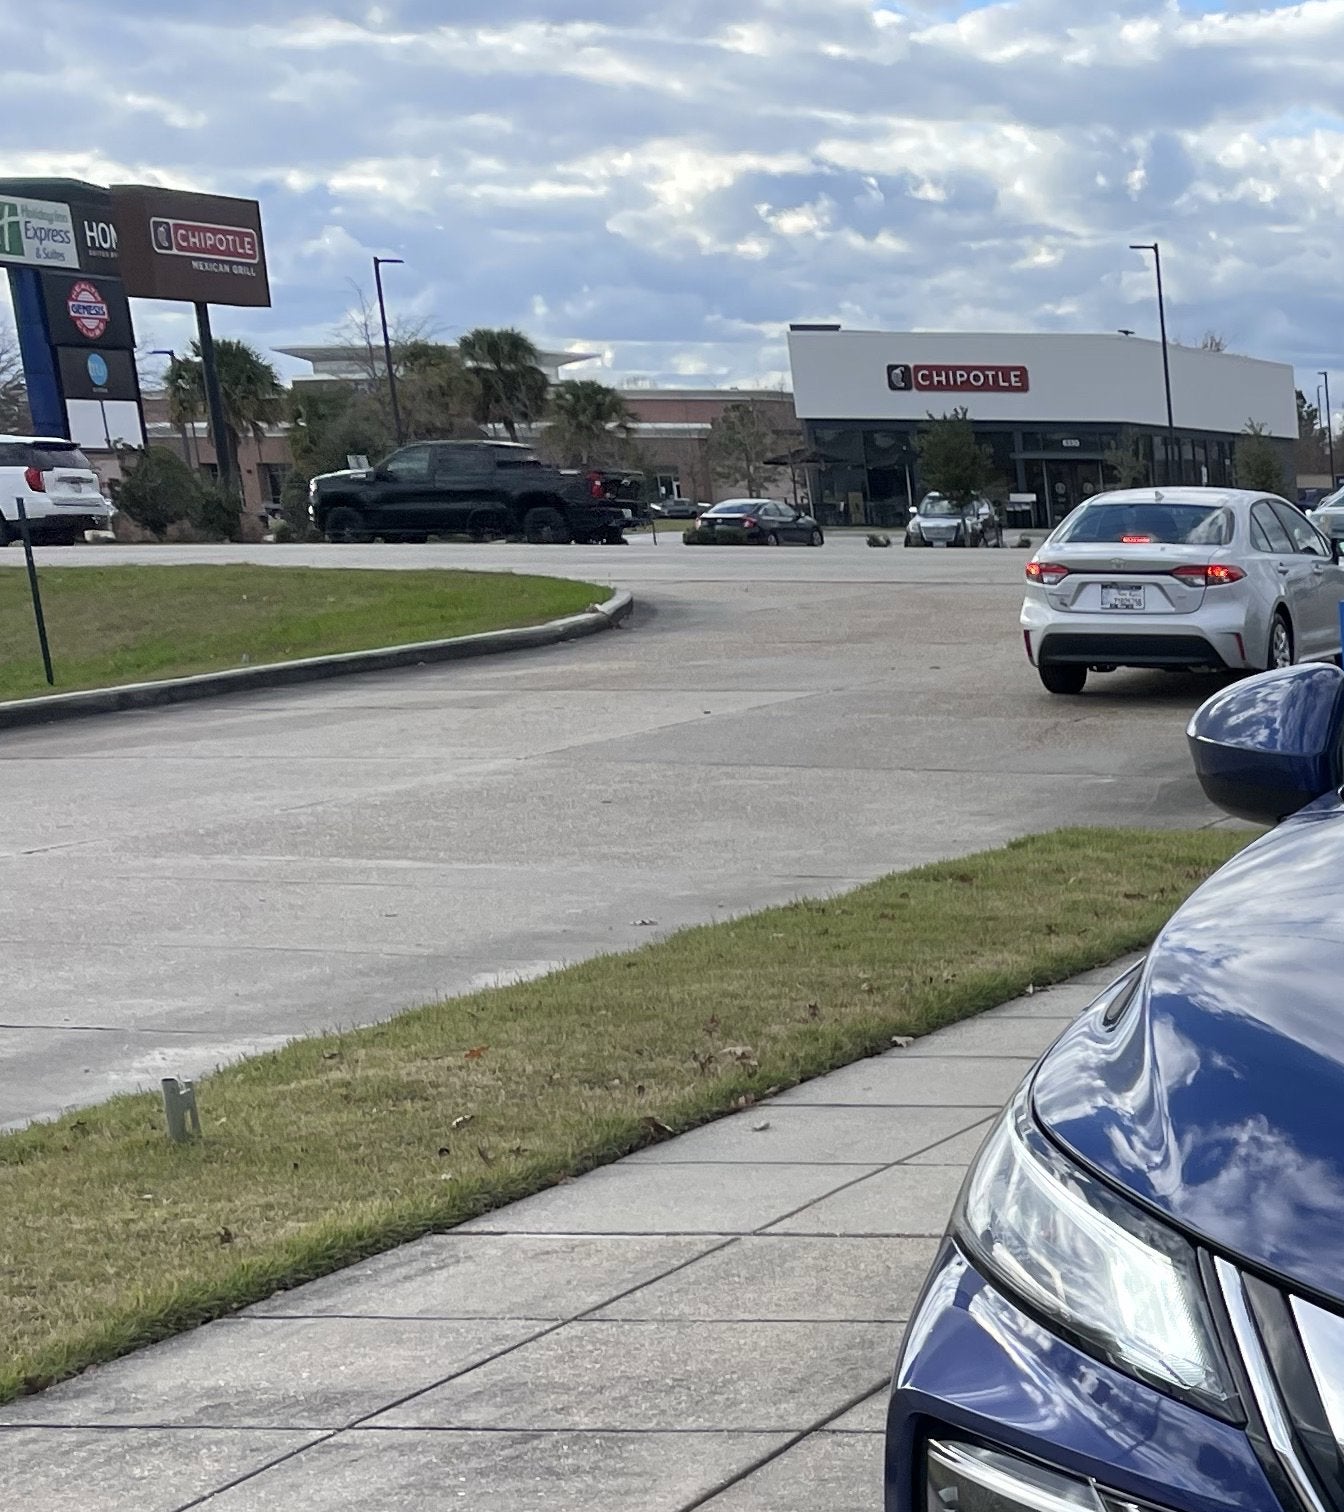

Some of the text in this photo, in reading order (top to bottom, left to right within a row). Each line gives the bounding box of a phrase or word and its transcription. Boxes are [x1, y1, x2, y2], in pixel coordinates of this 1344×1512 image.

[25, 220, 71, 245] Express
[177, 229, 254, 255] CHIPOTLE
[43, 248, 66, 261] Suites
[191, 260, 256, 277] MEXICAN GRILL
[71, 303, 106, 316] GENESIS
[917, 370, 1023, 387] CHIPOTLE
